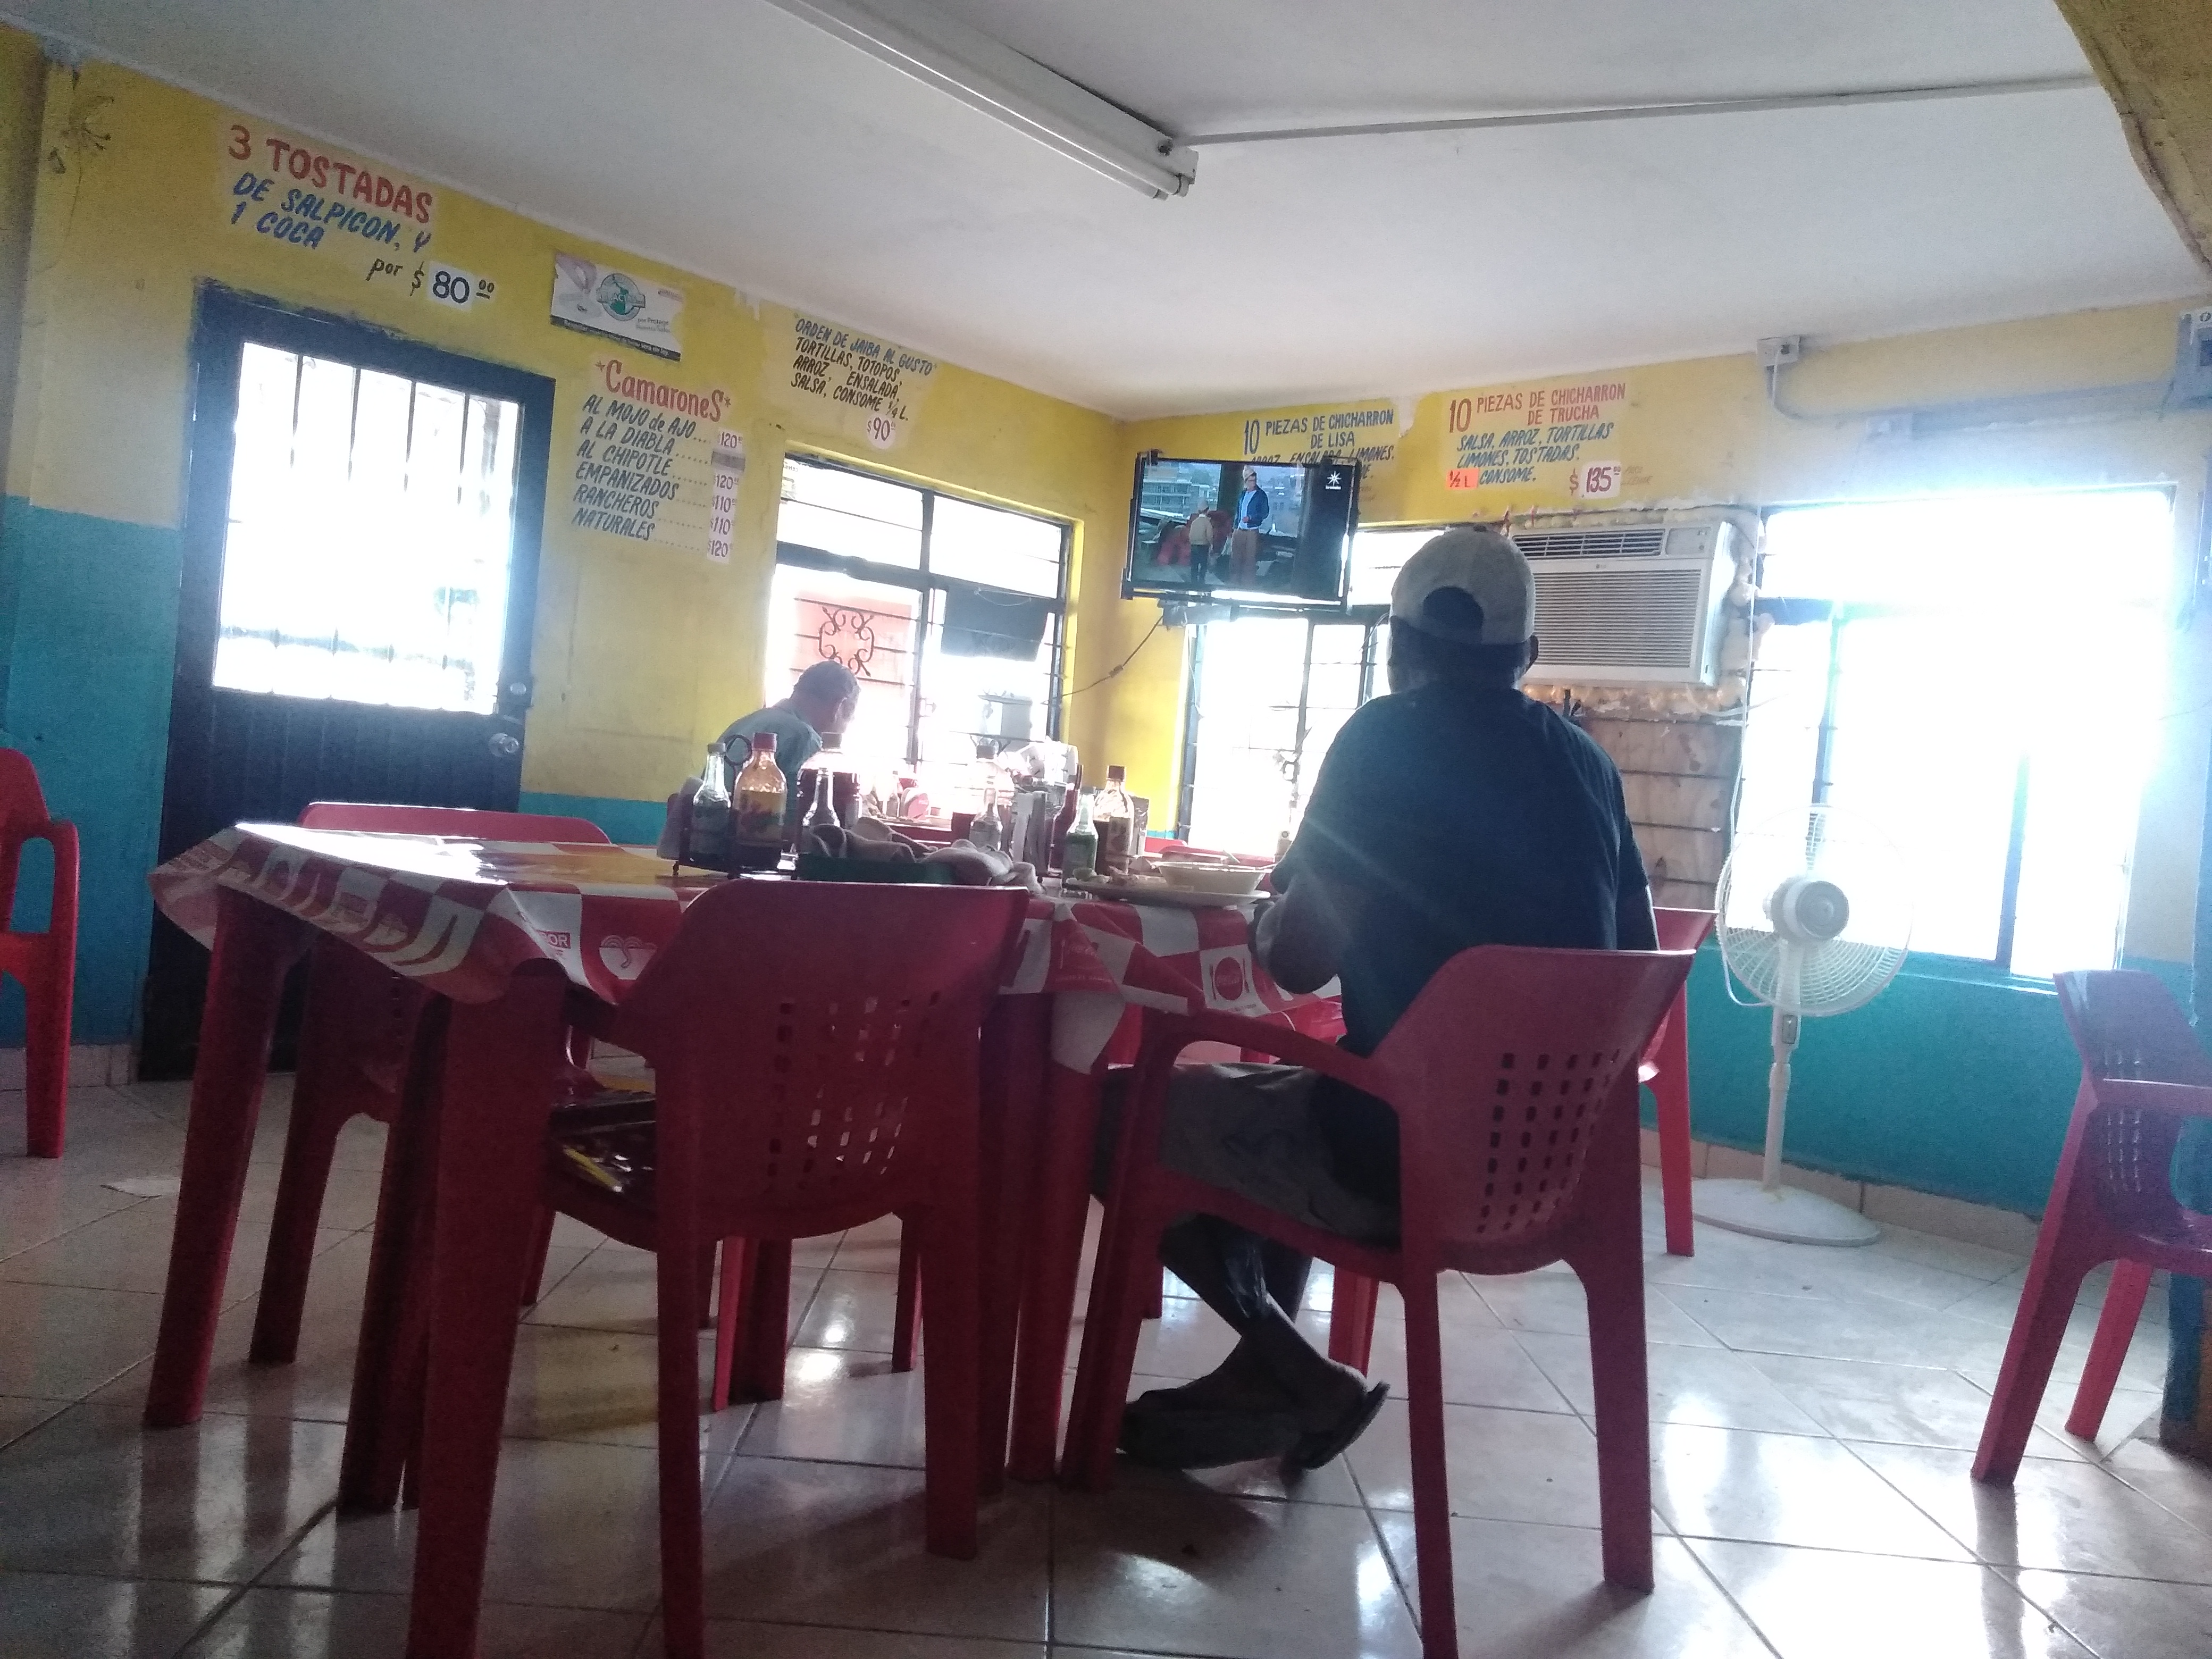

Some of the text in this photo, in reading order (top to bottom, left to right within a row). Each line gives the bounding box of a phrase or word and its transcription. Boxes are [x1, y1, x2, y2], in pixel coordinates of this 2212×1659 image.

[229, 124, 432, 224] 3 TOSTADAS
[230, 200, 325, 249] 1 COCA
[233, 172, 275, 202] DE
[413, 230, 431, 253] Y
[365, 258, 403, 281] por
[795, 319, 932, 376] ORDEN DE JAIBA AL GUSTO
[795, 337, 902, 386] TORTILLAS, TOTOPOS,
[791, 372, 827, 398] SALSA,
[833, 386, 883, 412] CONSOME
[1449, 383, 1626, 433] 10 PIEZAS DE CHICHARRON
[582, 394, 604, 415] AL
[606, 400, 650, 426] MOJO
[649, 412, 665, 432] de
[1244, 409, 1394, 455] 10 PIEZAS DE CHICHARRON
[1527, 405, 1599, 426] DE TRUCHA
[1546, 422, 1614, 443] TORTILLAS
[580, 416, 675, 456] A LA DIABLA
[1311, 431, 1355, 449] DE LISA
[577, 439, 596, 458] AL
[602, 445, 673, 477] CHIPOTLE
[575, 461, 680, 500] EMPANIZADOS
[573, 484, 659, 520] RANCHEROS
[571, 507, 655, 541] NATURALES
